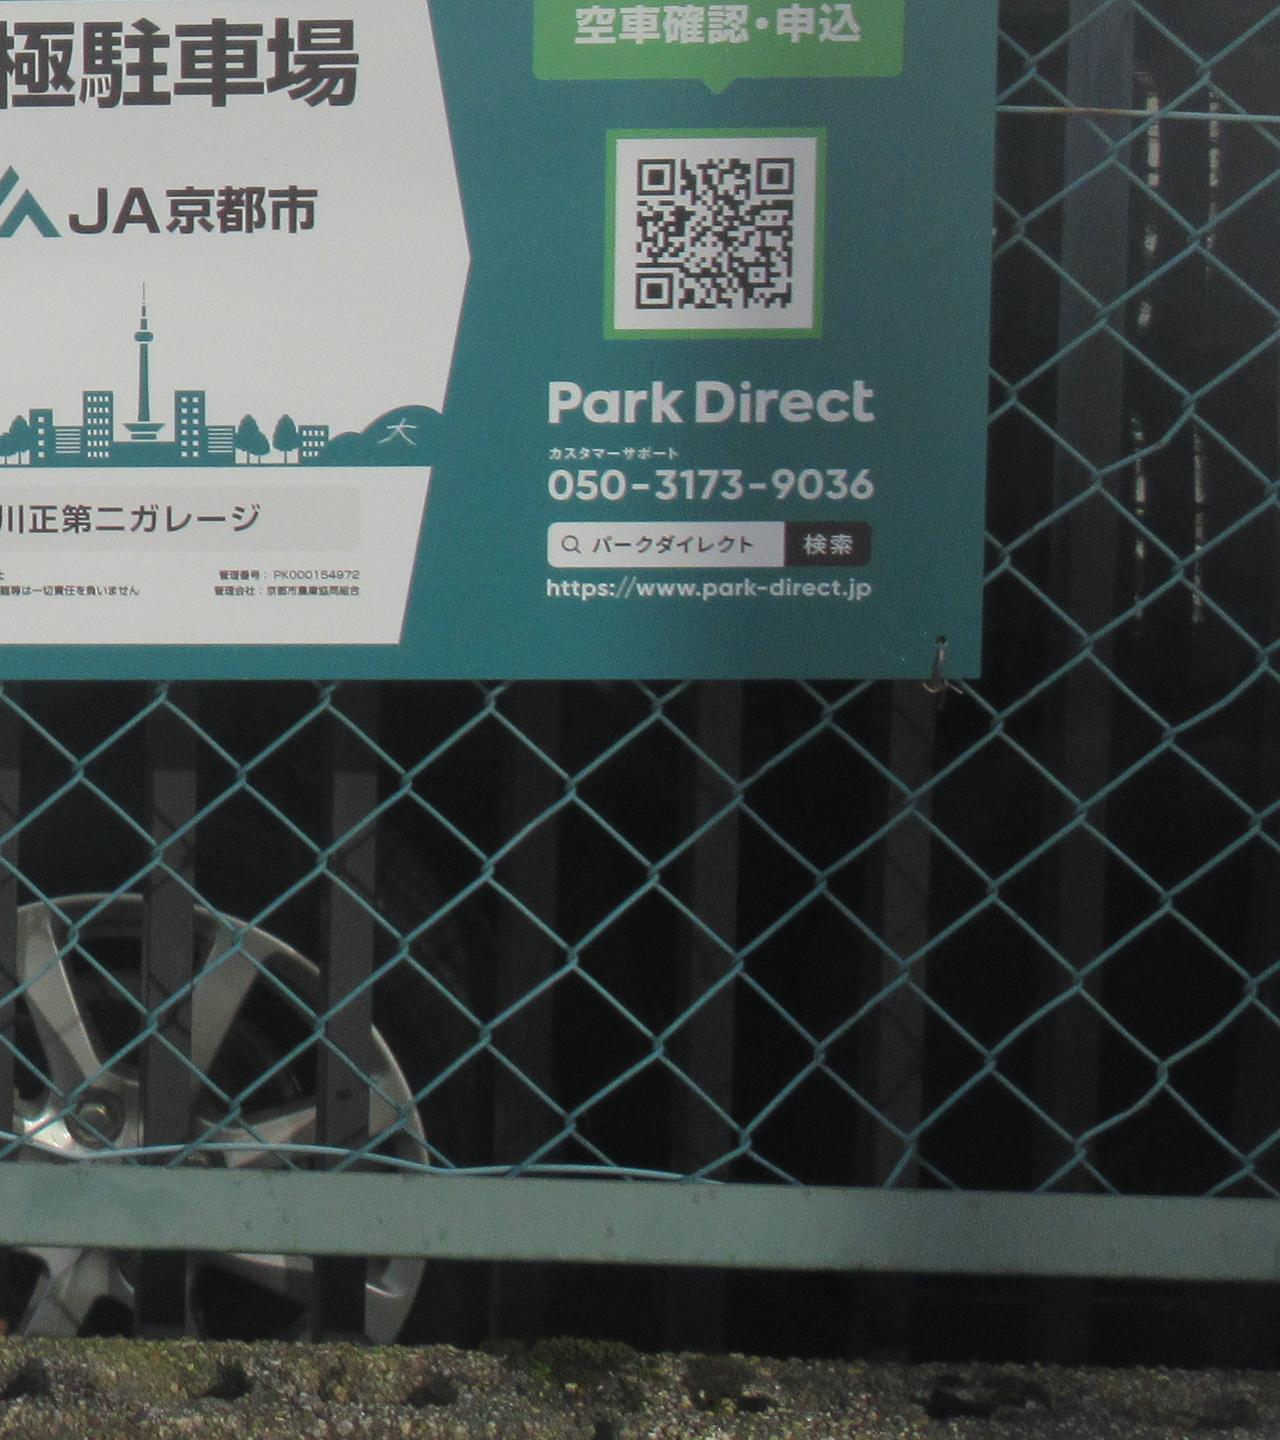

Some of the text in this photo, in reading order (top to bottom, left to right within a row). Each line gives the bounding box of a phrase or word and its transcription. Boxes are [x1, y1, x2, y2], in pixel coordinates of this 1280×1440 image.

[574, 3, 859, 45] 空車確認・申込
[68, 184, 318, 235] JA京都市
[548, 379, 875, 424] Park Direct
[549, 446, 677, 461] カスタマーサポート
[547, 468, 874, 501] 050-3173-9036
[593, 533, 853, 555] パークダイレクト 検索
[545, 576, 871, 602] https://www.park-direct.jp
